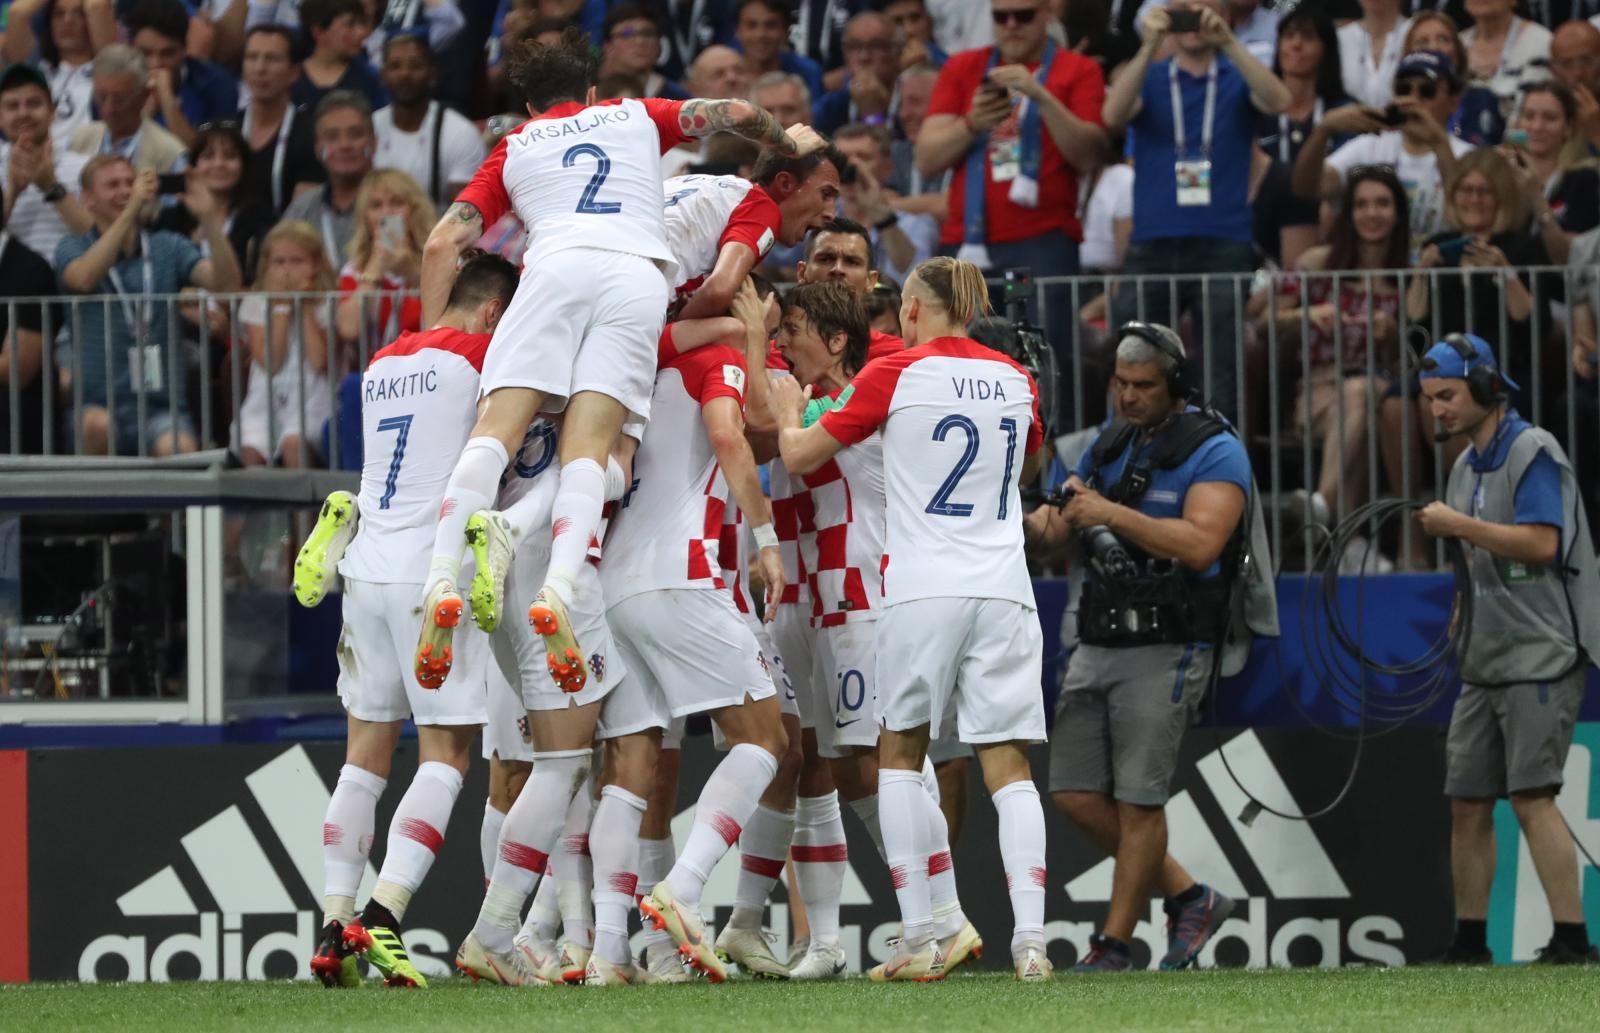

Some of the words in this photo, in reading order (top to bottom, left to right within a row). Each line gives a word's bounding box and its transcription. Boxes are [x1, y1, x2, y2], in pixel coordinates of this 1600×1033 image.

[516, 110, 630, 147] VRSALJKO
[562, 143, 622, 214] 2
[365, 364, 438, 403] RAKITIĆ
[951, 377, 1007, 402] VIDA
[376, 414, 415, 510] 7
[924, 413, 1018, 521] 21
[836, 669, 866, 712] 10
[77, 910, 453, 984] adids
[1044, 898, 1407, 970] addas
